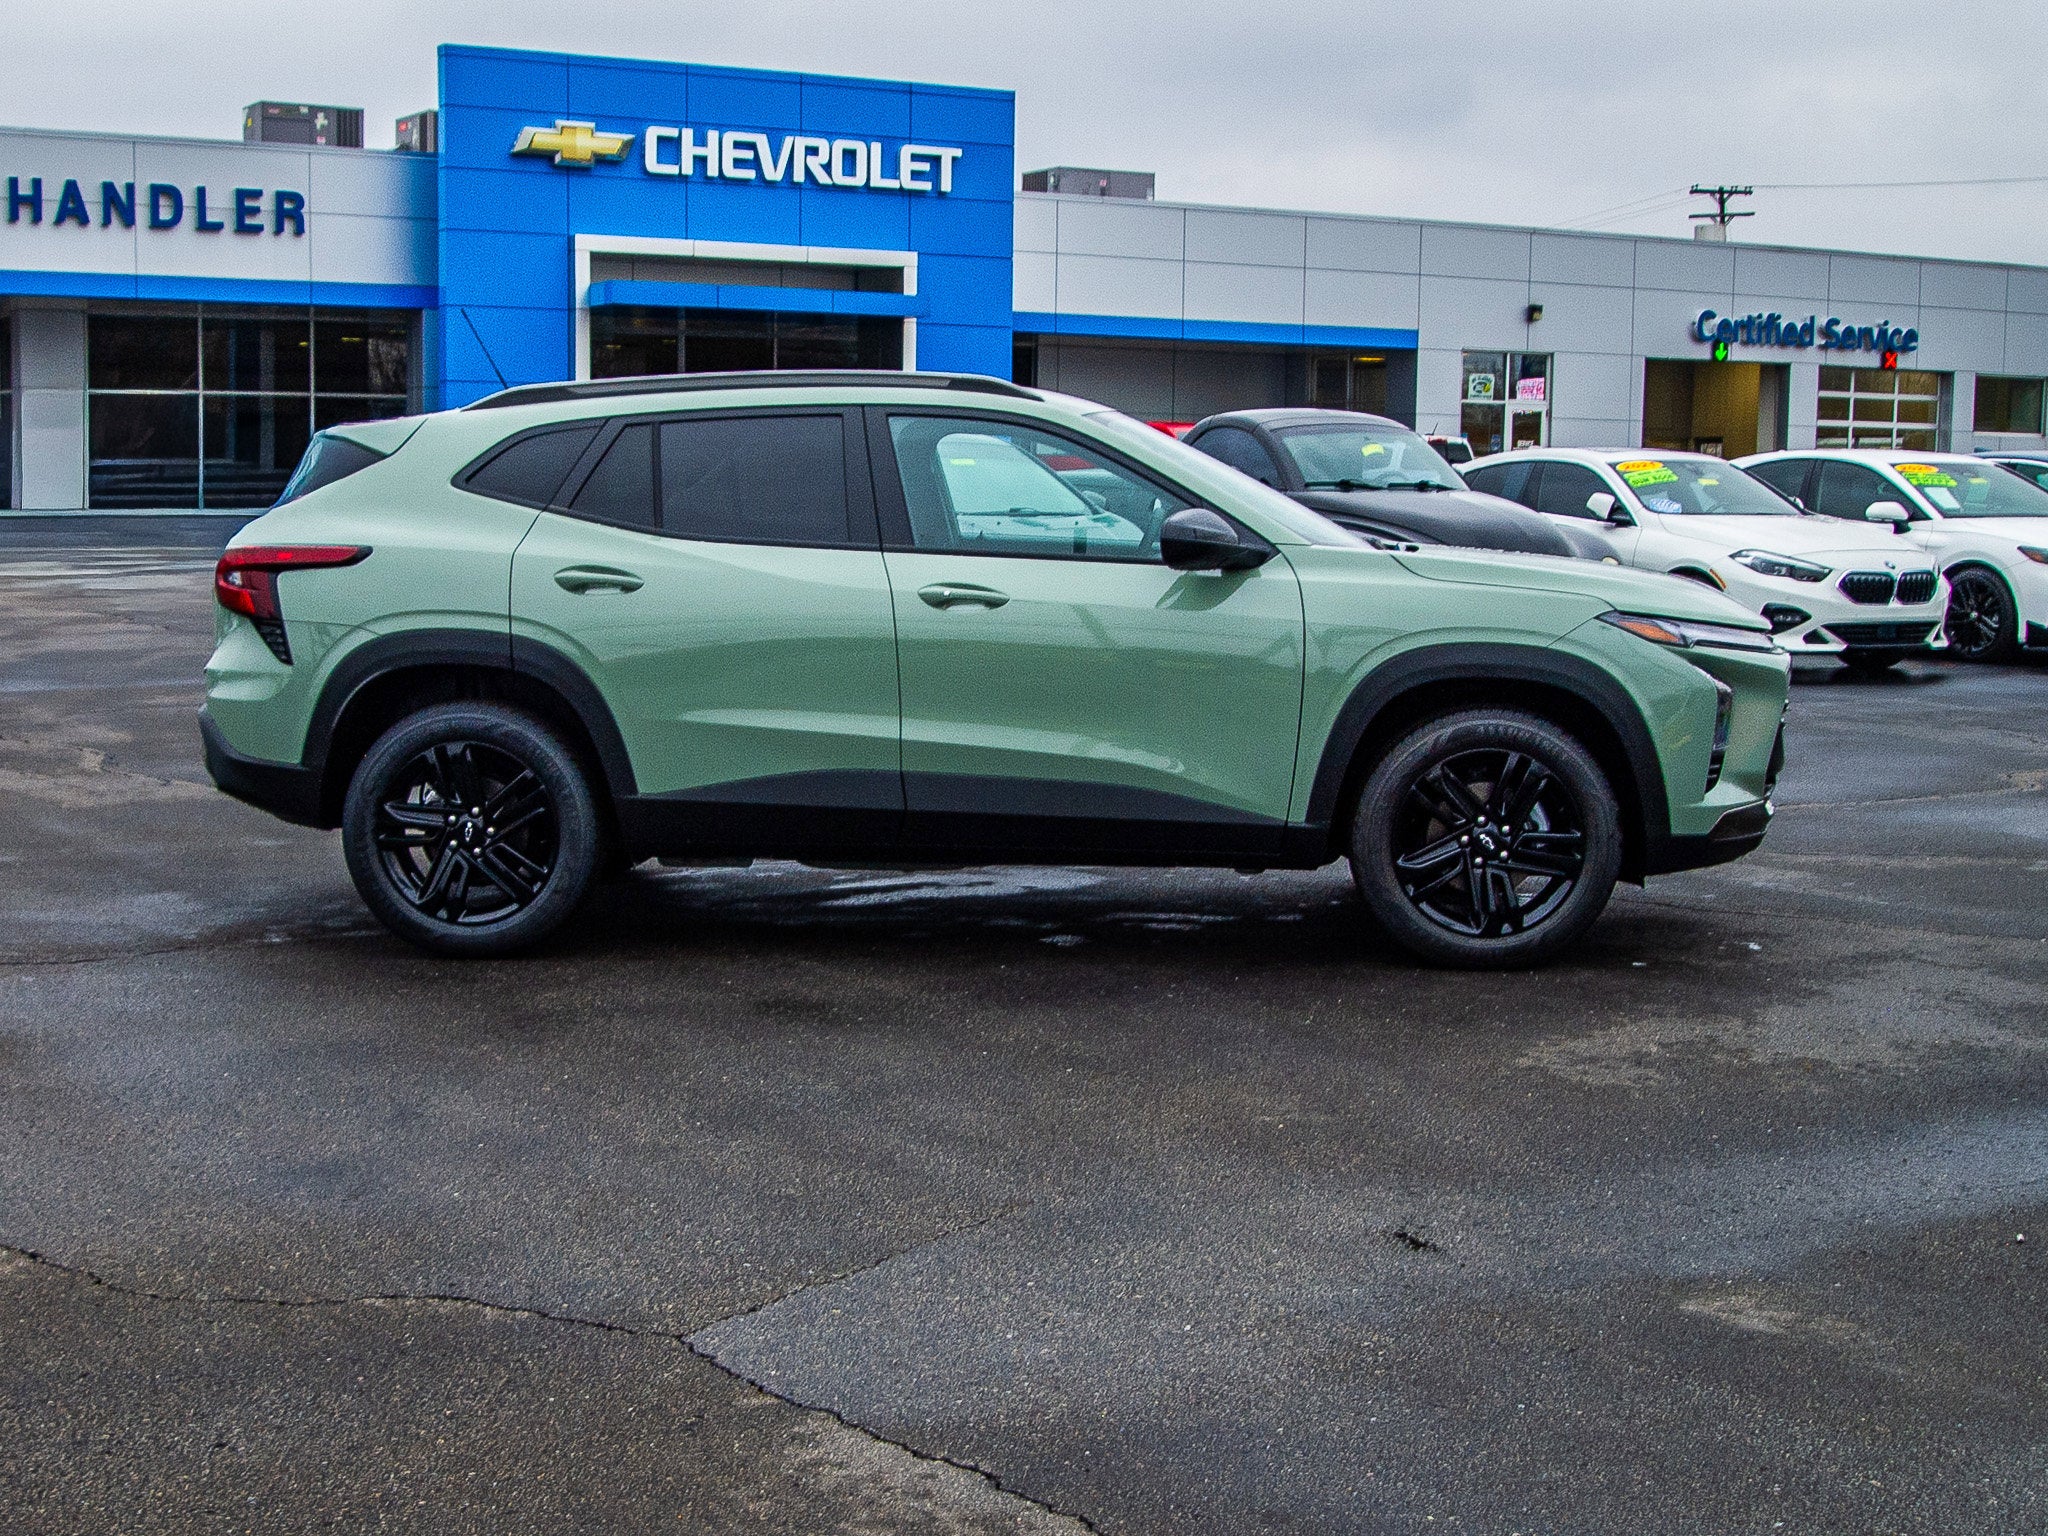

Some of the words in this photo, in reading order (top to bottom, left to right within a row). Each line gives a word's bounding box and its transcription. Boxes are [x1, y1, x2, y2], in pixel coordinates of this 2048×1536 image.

[645, 125, 962, 193] CHEVROLET
[7, 176, 306, 236] HANDLER
[1696, 309, 1816, 348] Certified
[1823, 316, 1920, 352] Service
